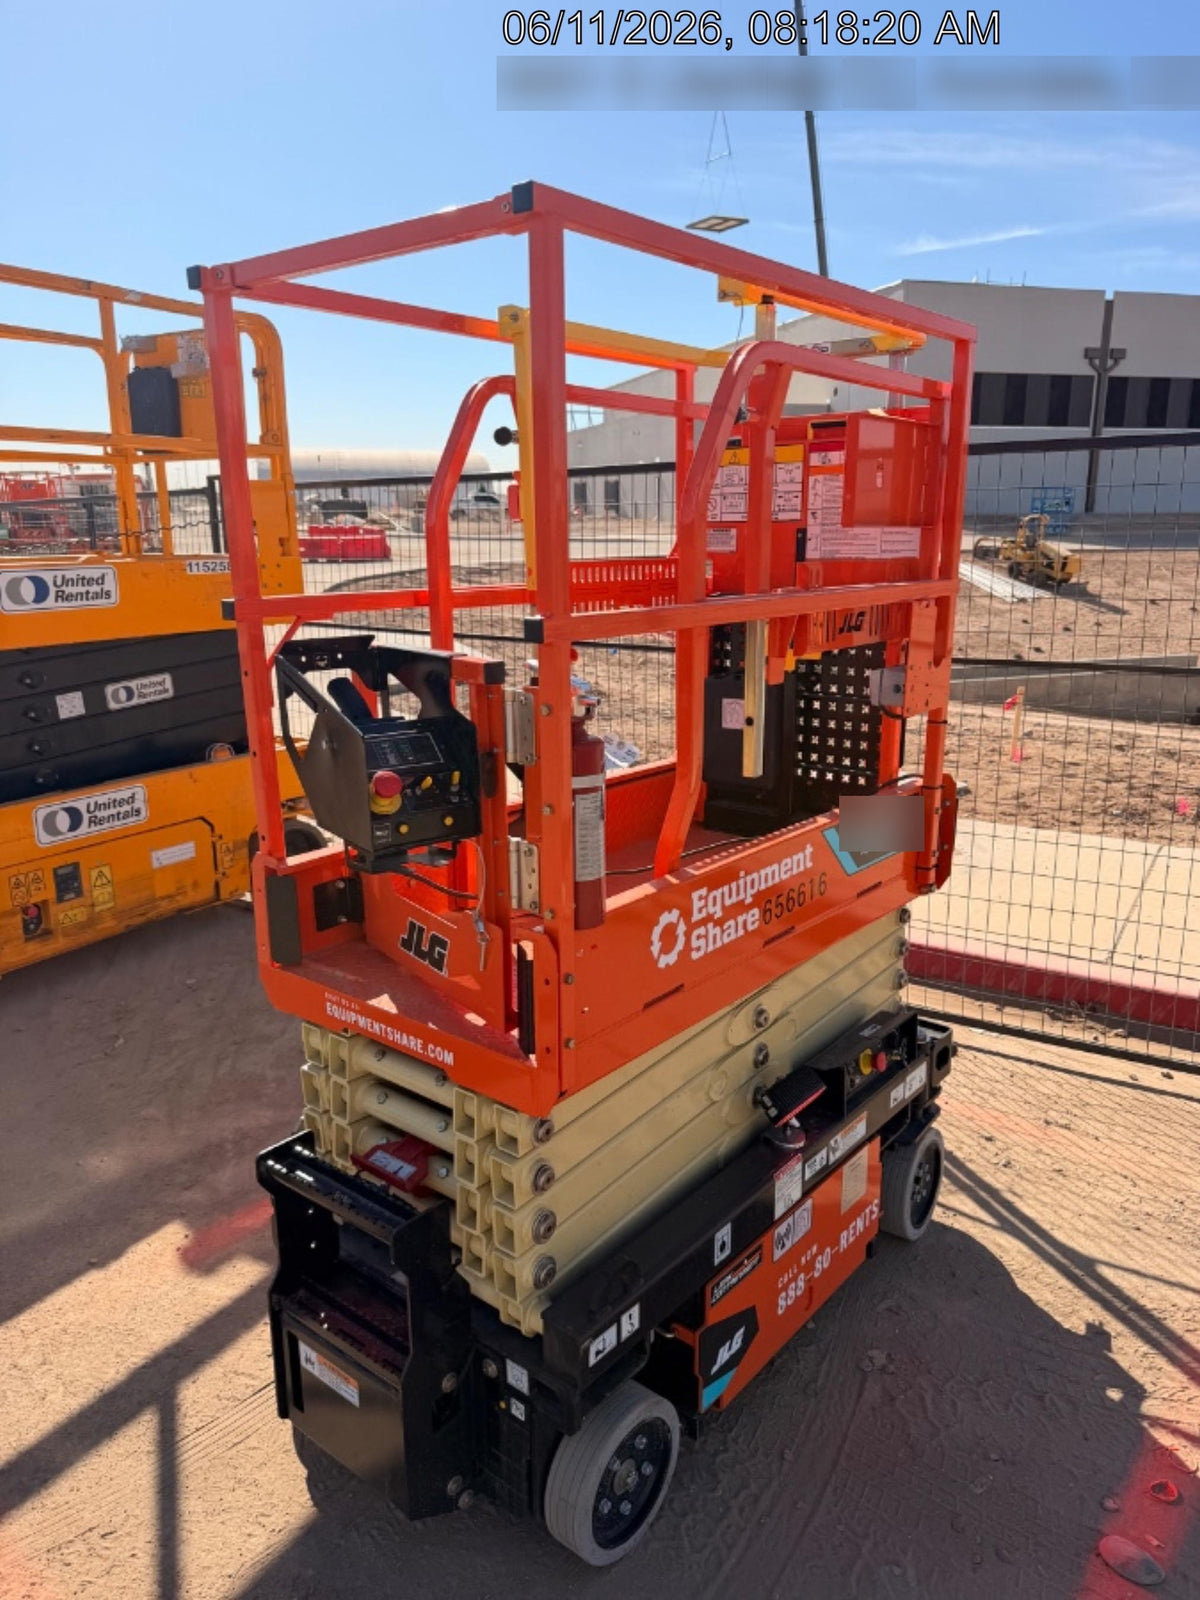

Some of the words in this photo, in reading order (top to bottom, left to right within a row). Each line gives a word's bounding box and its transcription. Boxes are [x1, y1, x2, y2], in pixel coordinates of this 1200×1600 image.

[53, 573, 105, 588] United
[54, 588, 111, 603] Rentals
[839, 611, 866, 634] JLG
[136, 677, 166, 691] United
[86, 792, 136, 815] United
[88, 806, 141, 829] Rentals
[691, 844, 814, 922] Equipment
[761, 871, 828, 926] 656616
[398, 916, 450, 978] JLG
[691, 905, 761, 961] Share
[326, 1001, 455, 1067] EQUIPMENTSHARE.COM
[778, 1198, 881, 1316] 888-80-RENTS
[710, 1325, 746, 1376] JLG
